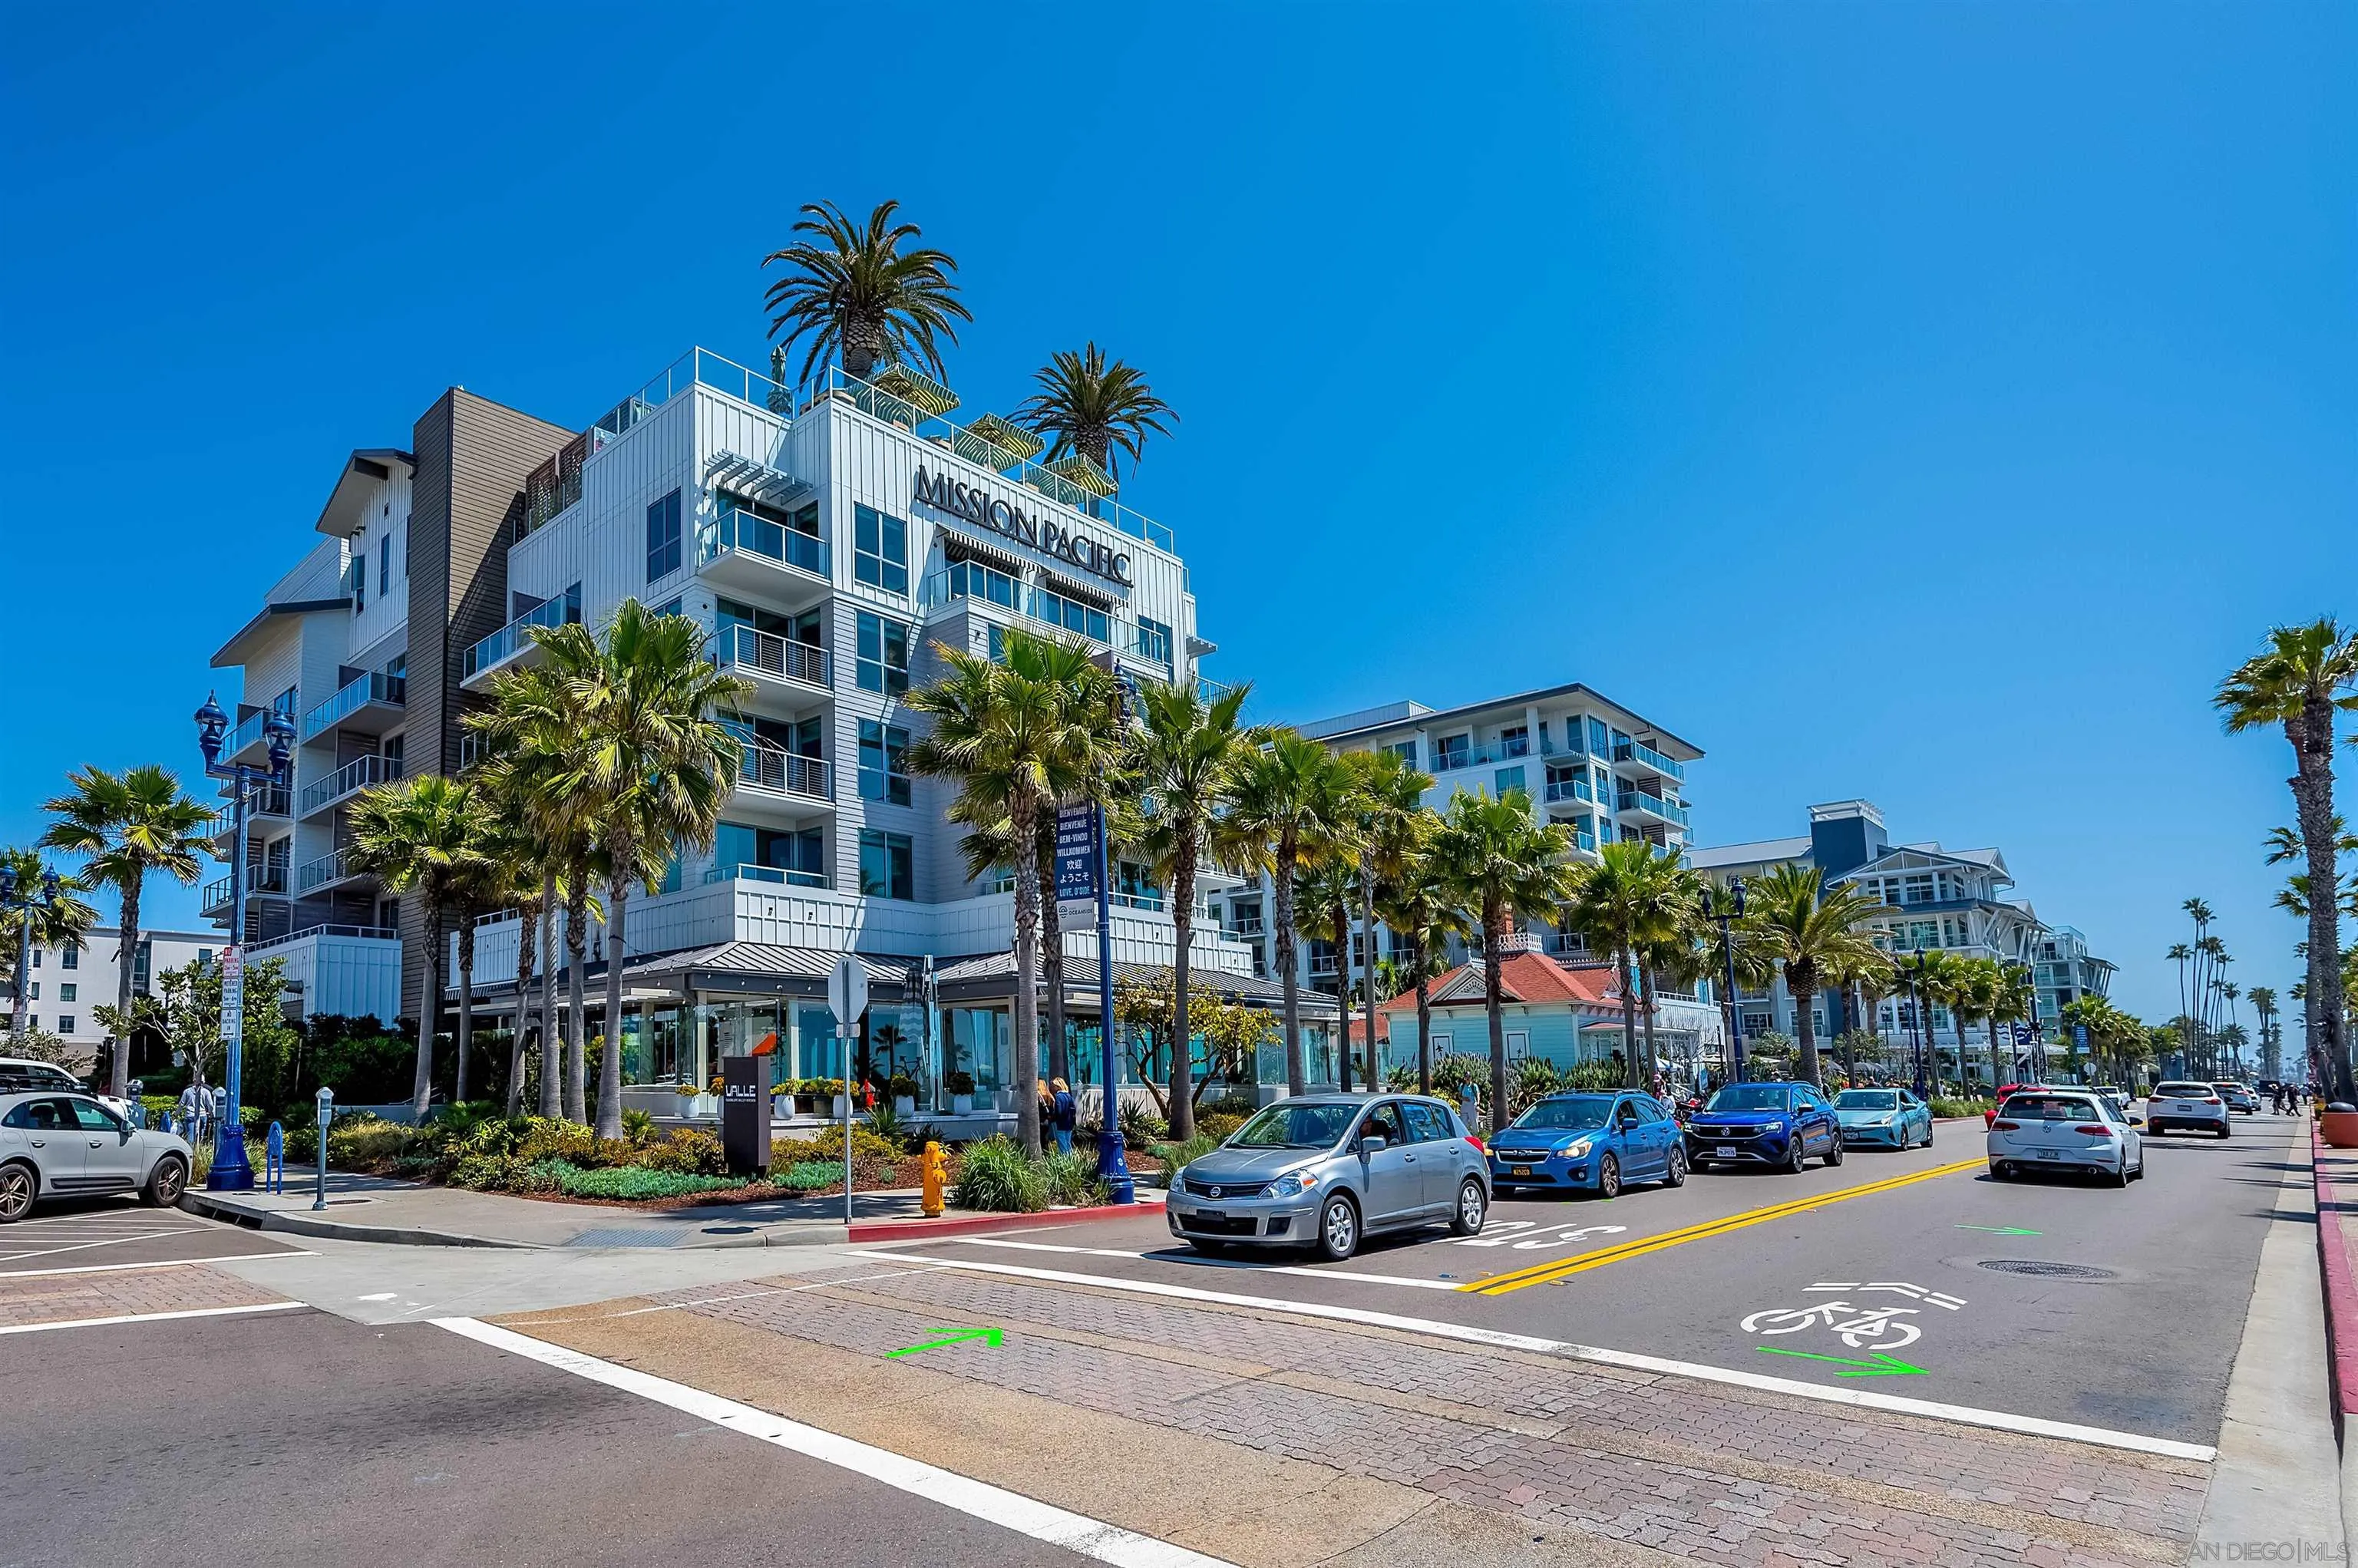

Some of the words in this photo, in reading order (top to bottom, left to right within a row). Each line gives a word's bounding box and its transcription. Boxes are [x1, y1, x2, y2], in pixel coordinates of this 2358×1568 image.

[916, 464, 1038, 545] MISSION
[1044, 520, 1132, 585] PACIFIC
[1060, 819, 1087, 830] BIENVENUE
[1059, 832, 1088, 843] BEM-VINDO
[1057, 845, 1091, 857] WILLKOMMEN
[1067, 859, 1082, 870] 欢迎
[1060, 872, 1089, 883] ようこそ
[725, 1084, 756, 1097] VALLE
